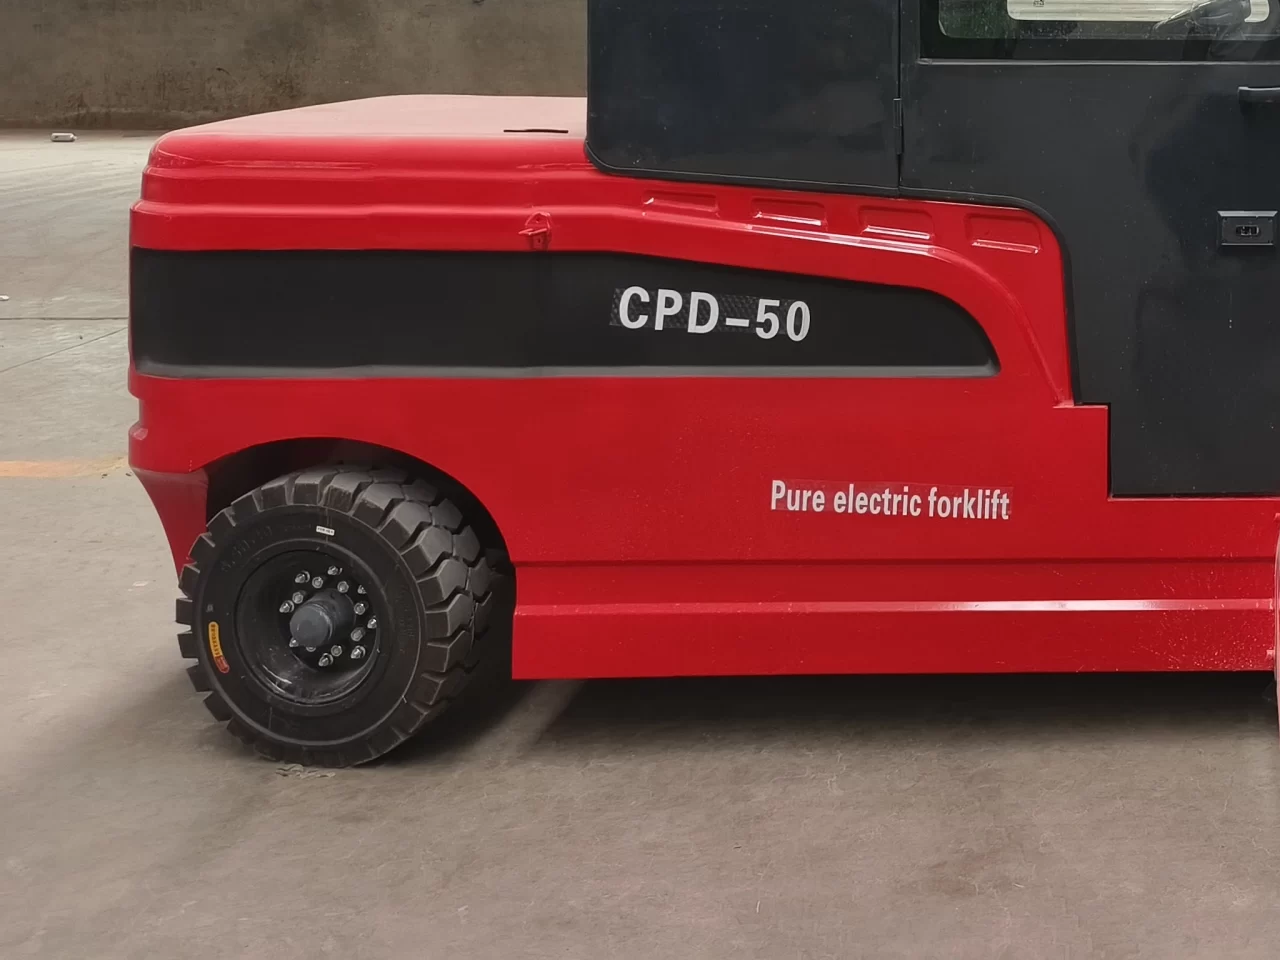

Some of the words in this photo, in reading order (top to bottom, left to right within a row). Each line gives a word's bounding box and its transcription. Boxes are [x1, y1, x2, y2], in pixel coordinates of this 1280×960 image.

[618, 286, 812, 342] CPD-50
[770, 479, 826, 512] Pure
[833, 483, 922, 517] electric
[927, 486, 1010, 520] forklift
